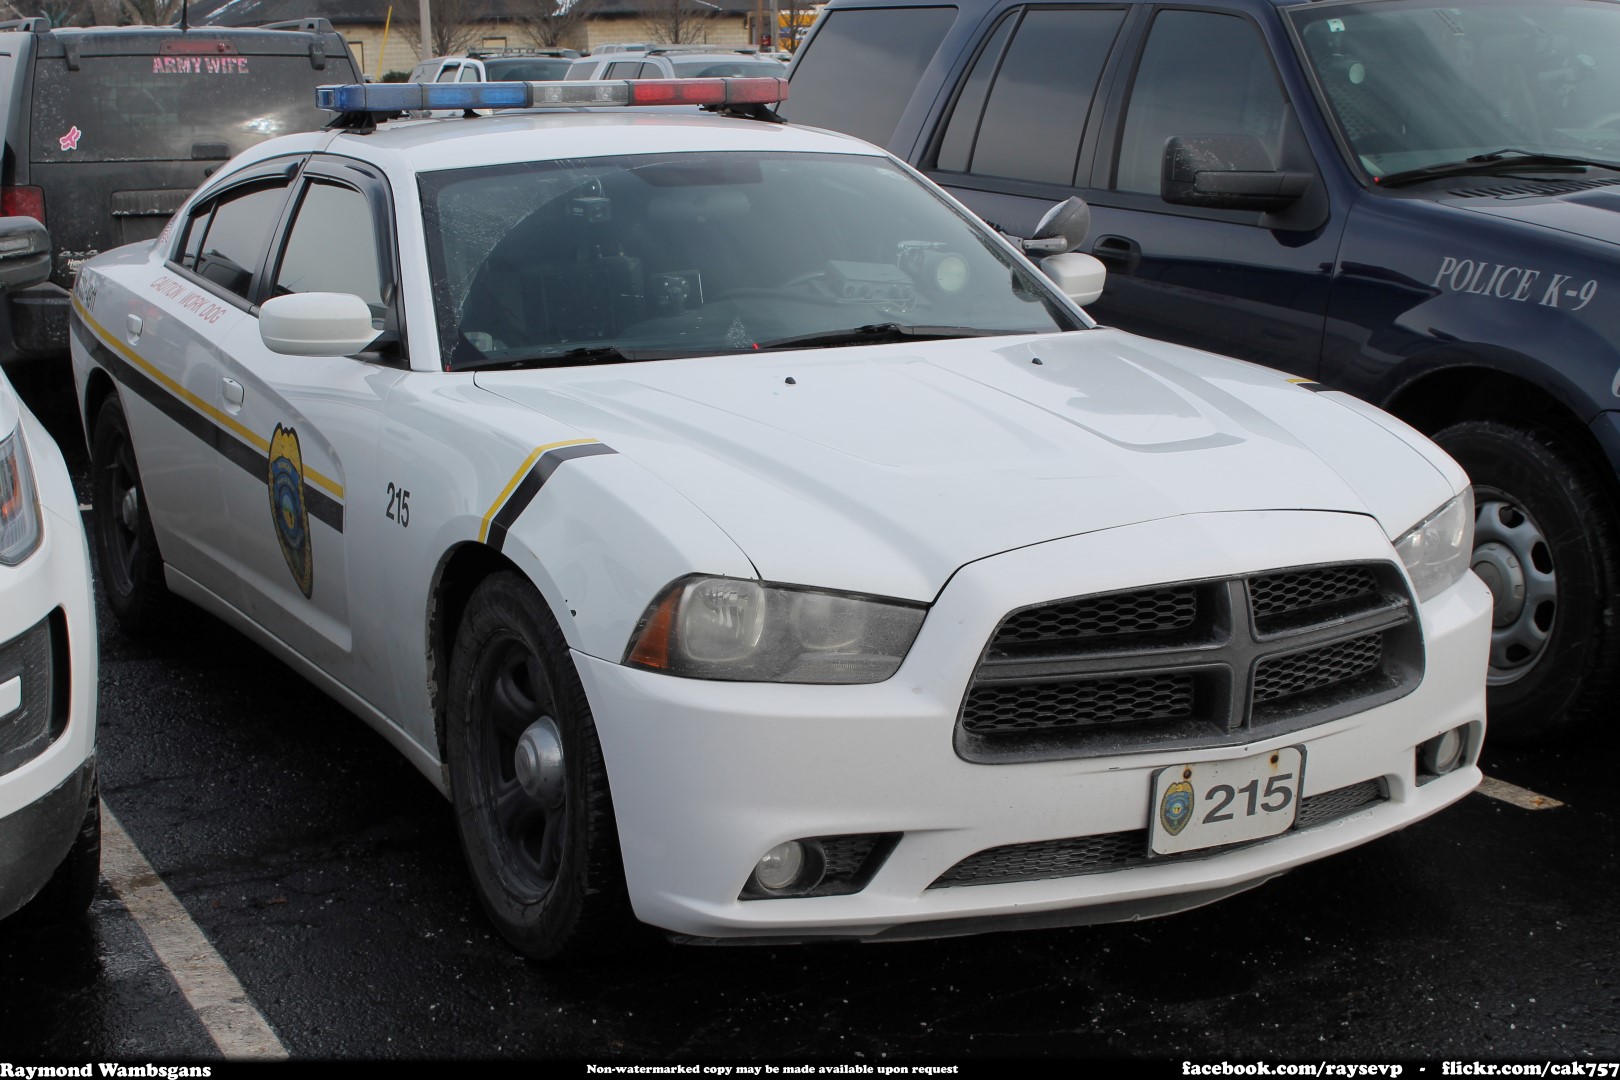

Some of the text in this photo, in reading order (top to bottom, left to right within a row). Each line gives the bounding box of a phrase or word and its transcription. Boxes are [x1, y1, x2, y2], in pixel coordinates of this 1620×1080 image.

[152, 56, 249, 74] ARMY WIFE
[150, 276, 228, 324] CAUTION WORK DOG
[1430, 256, 1598, 311] POLICE K-9
[385, 481, 411, 528] 215
[1202, 773, 1293, 825] 215
